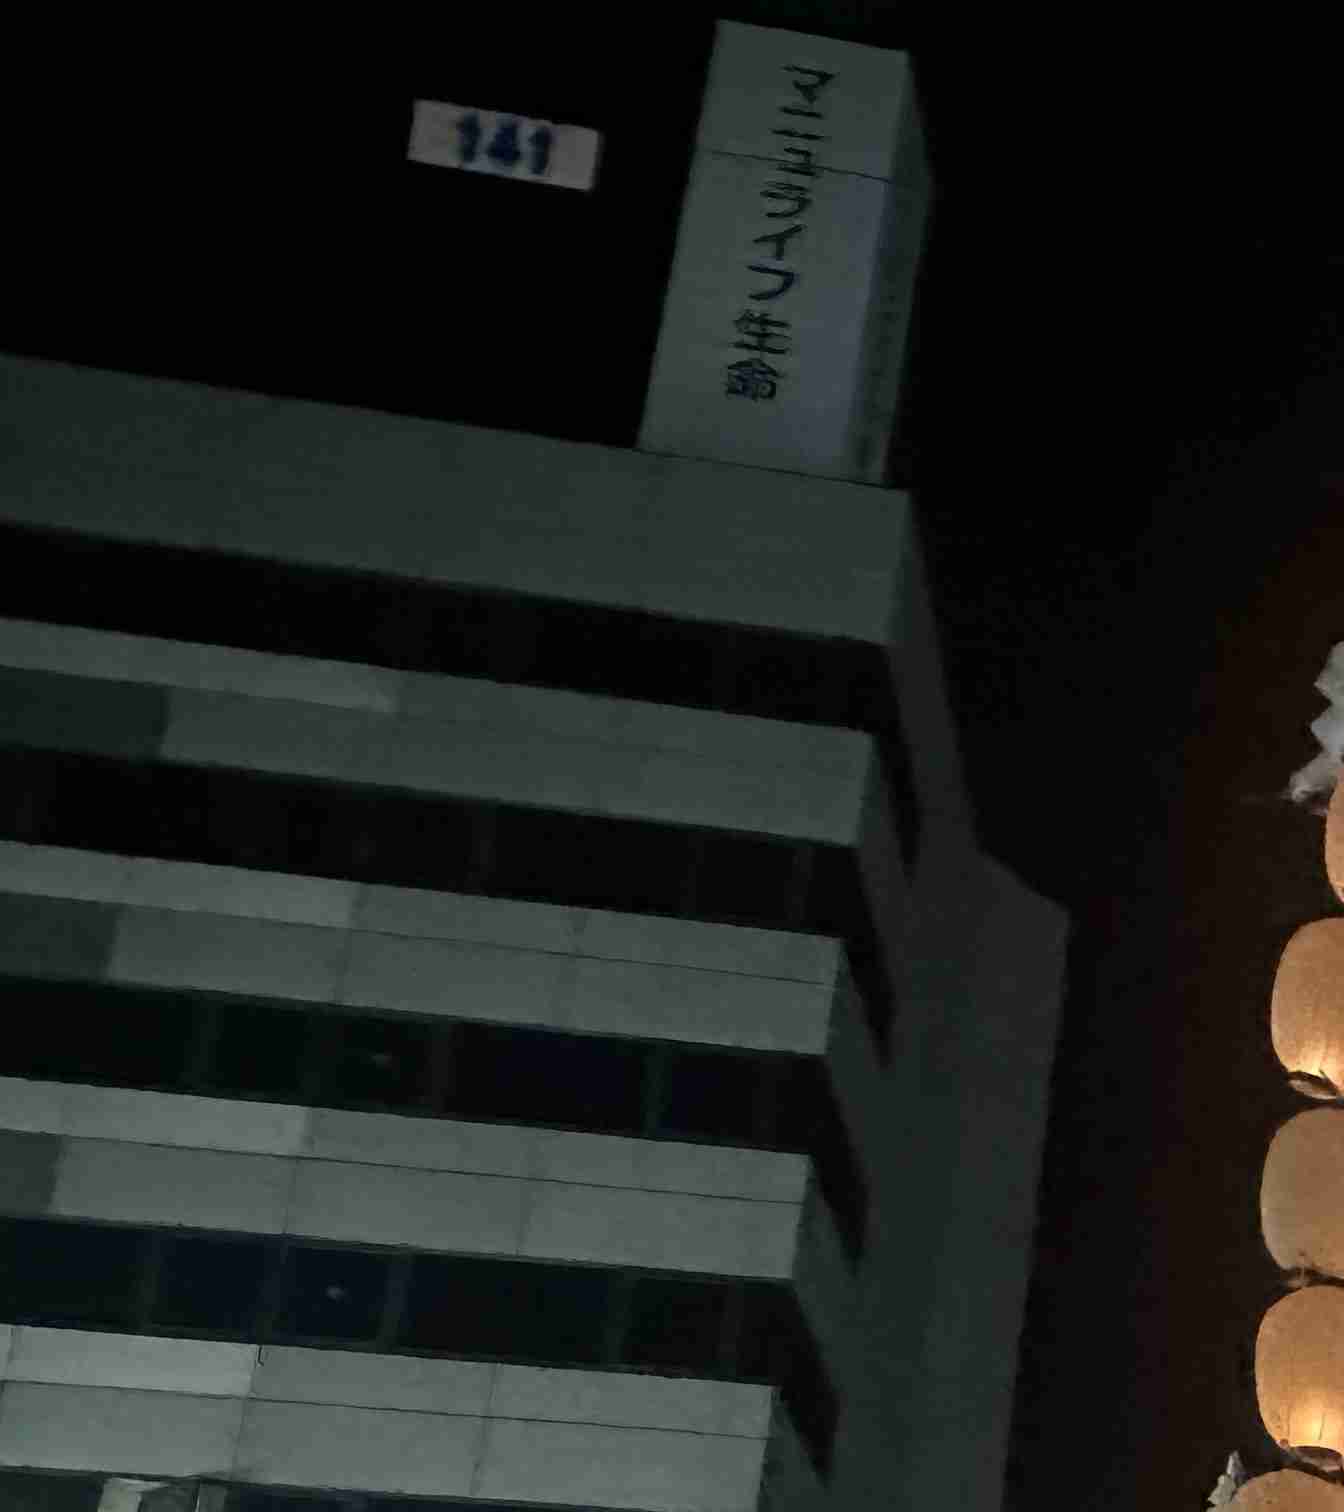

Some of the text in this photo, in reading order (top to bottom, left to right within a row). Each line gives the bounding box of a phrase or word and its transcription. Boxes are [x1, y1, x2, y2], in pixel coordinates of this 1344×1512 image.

[457, 113, 551, 175] 141
[723, 63, 839, 402] マニュライフ生命
